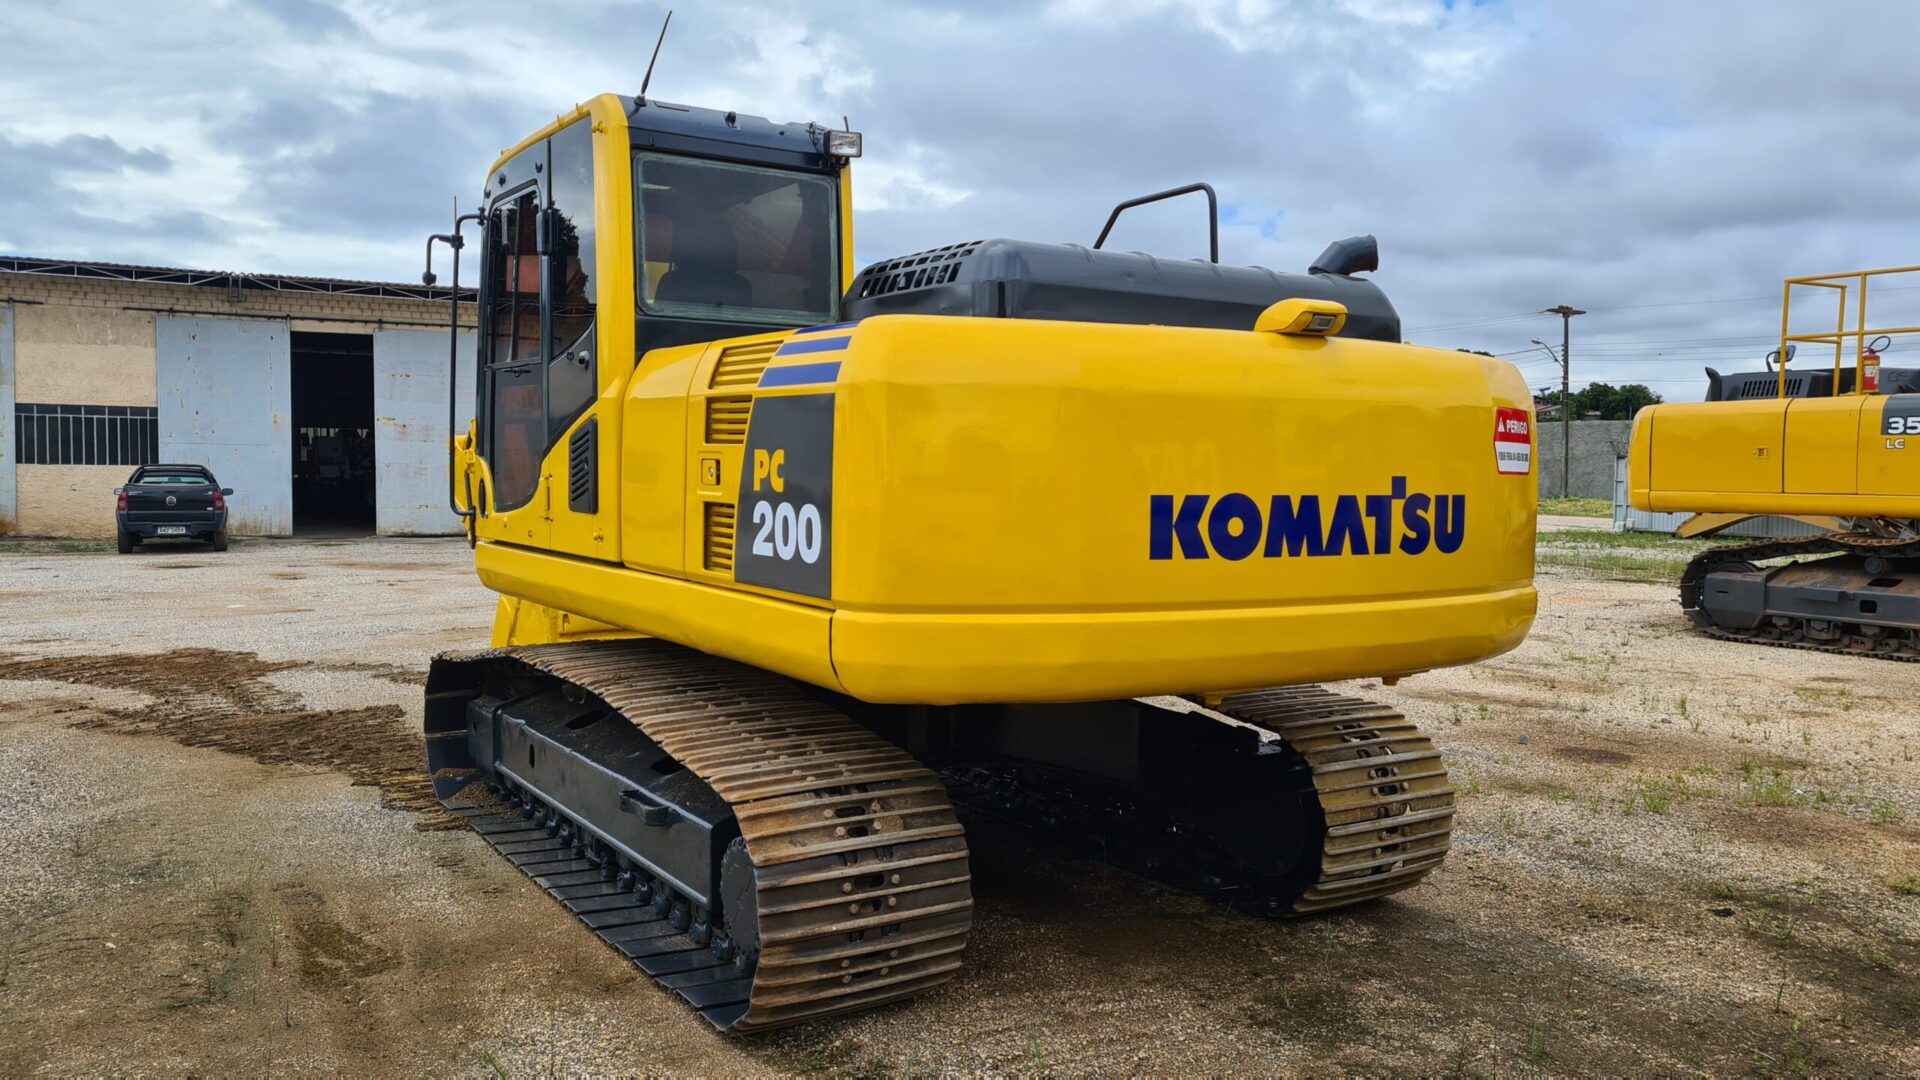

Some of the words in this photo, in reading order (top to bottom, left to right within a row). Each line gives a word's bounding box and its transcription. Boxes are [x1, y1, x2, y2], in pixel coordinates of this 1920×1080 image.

[1886, 438, 1905, 449] LC
[1887, 416, 1920, 435] 35
[753, 448, 785, 493] PC
[752, 500, 822, 564] 200
[1149, 475, 1466, 561] KOMATSU
